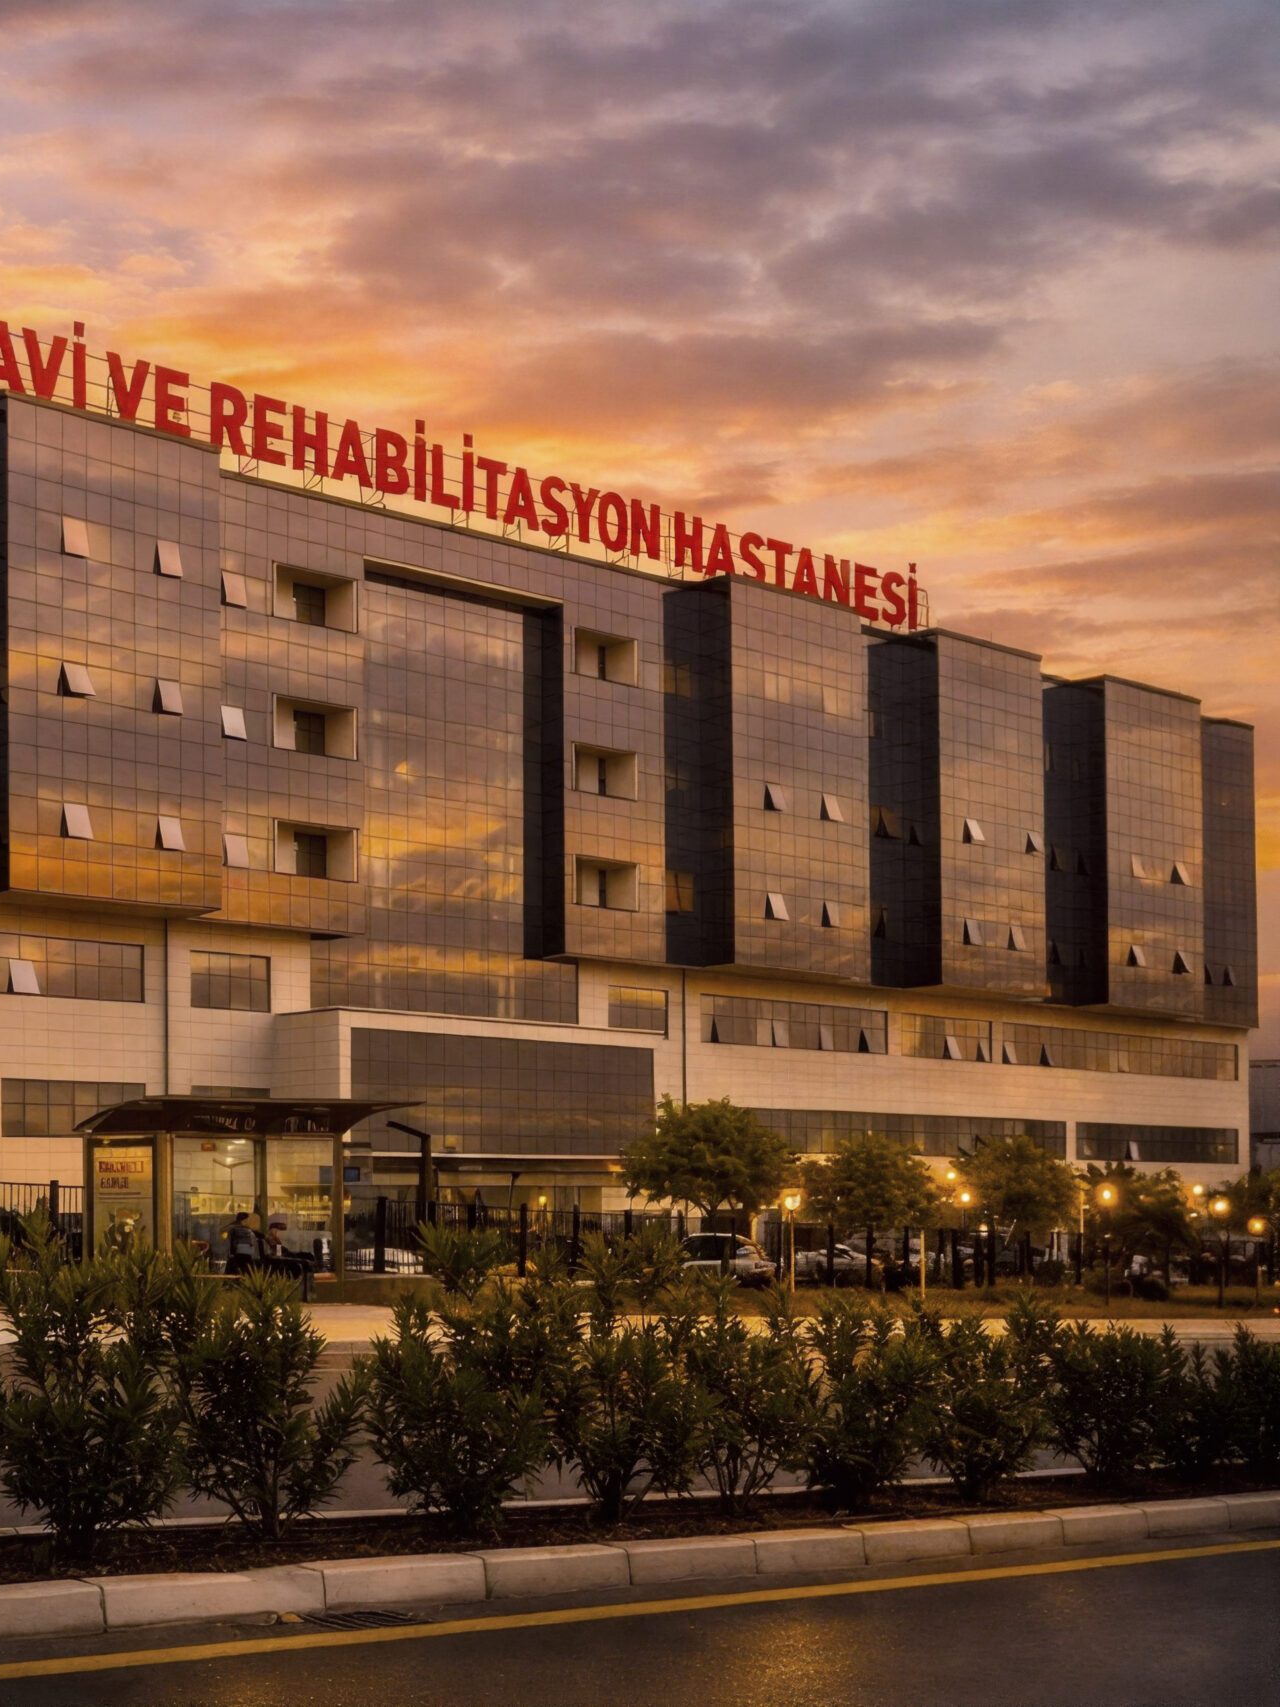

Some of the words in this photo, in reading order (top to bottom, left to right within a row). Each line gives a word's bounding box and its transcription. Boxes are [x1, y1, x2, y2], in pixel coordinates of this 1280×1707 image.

[106, 351, 192, 438] VE
[209, 382, 661, 561] REHABİLİTASYON
[673, 511, 921, 632] HASTANESİ
